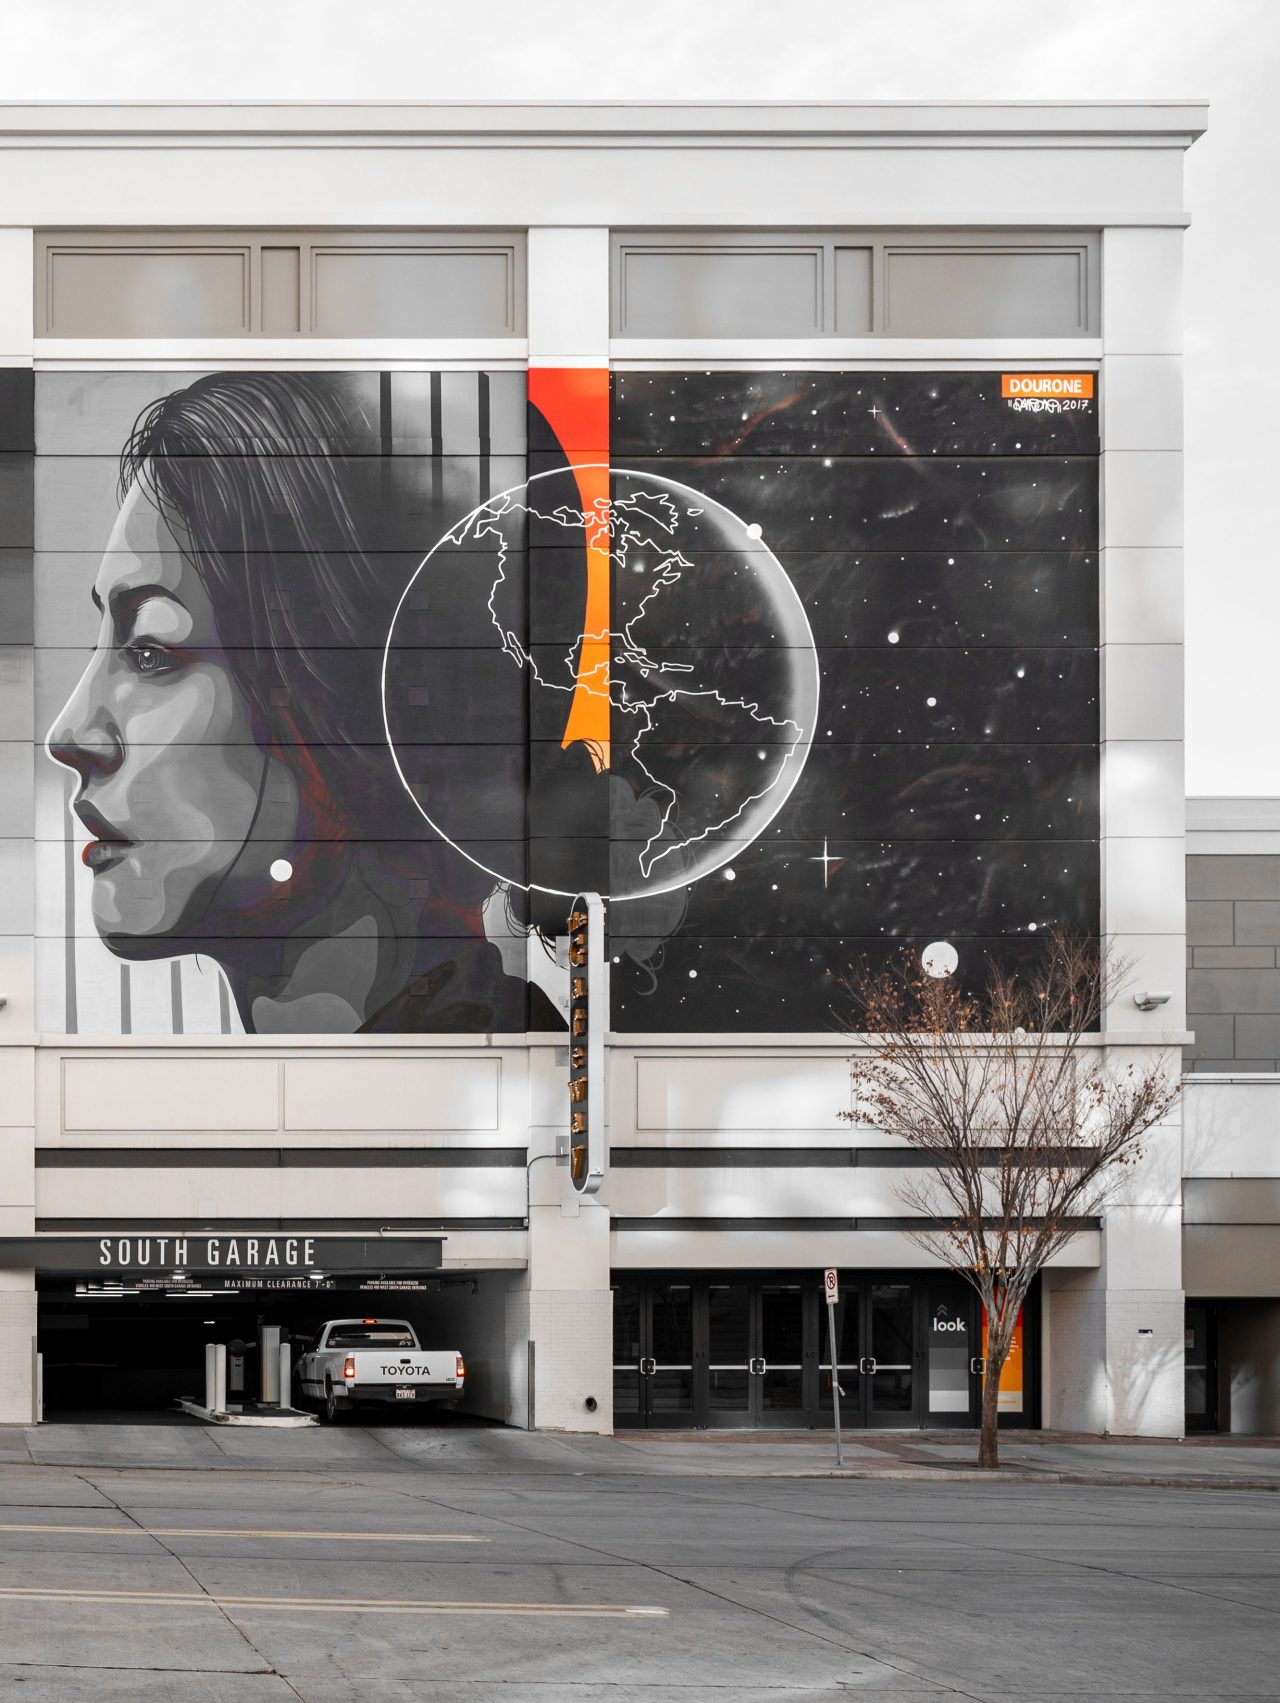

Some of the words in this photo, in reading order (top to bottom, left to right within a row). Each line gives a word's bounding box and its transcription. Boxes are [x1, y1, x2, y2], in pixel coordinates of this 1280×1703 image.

[1009, 378, 1082, 393] DOURONE
[1063, 399, 1089, 411] 2017
[99, 1239, 188, 1266] SOUTH
[207, 1239, 315, 1266] GARAGE
[224, 1280, 263, 1289] MAXIMUM
[267, 1280, 311, 1289] CLEARANCE
[933, 1317, 966, 1332] look
[380, 1365, 431, 1376] TOYOTA
